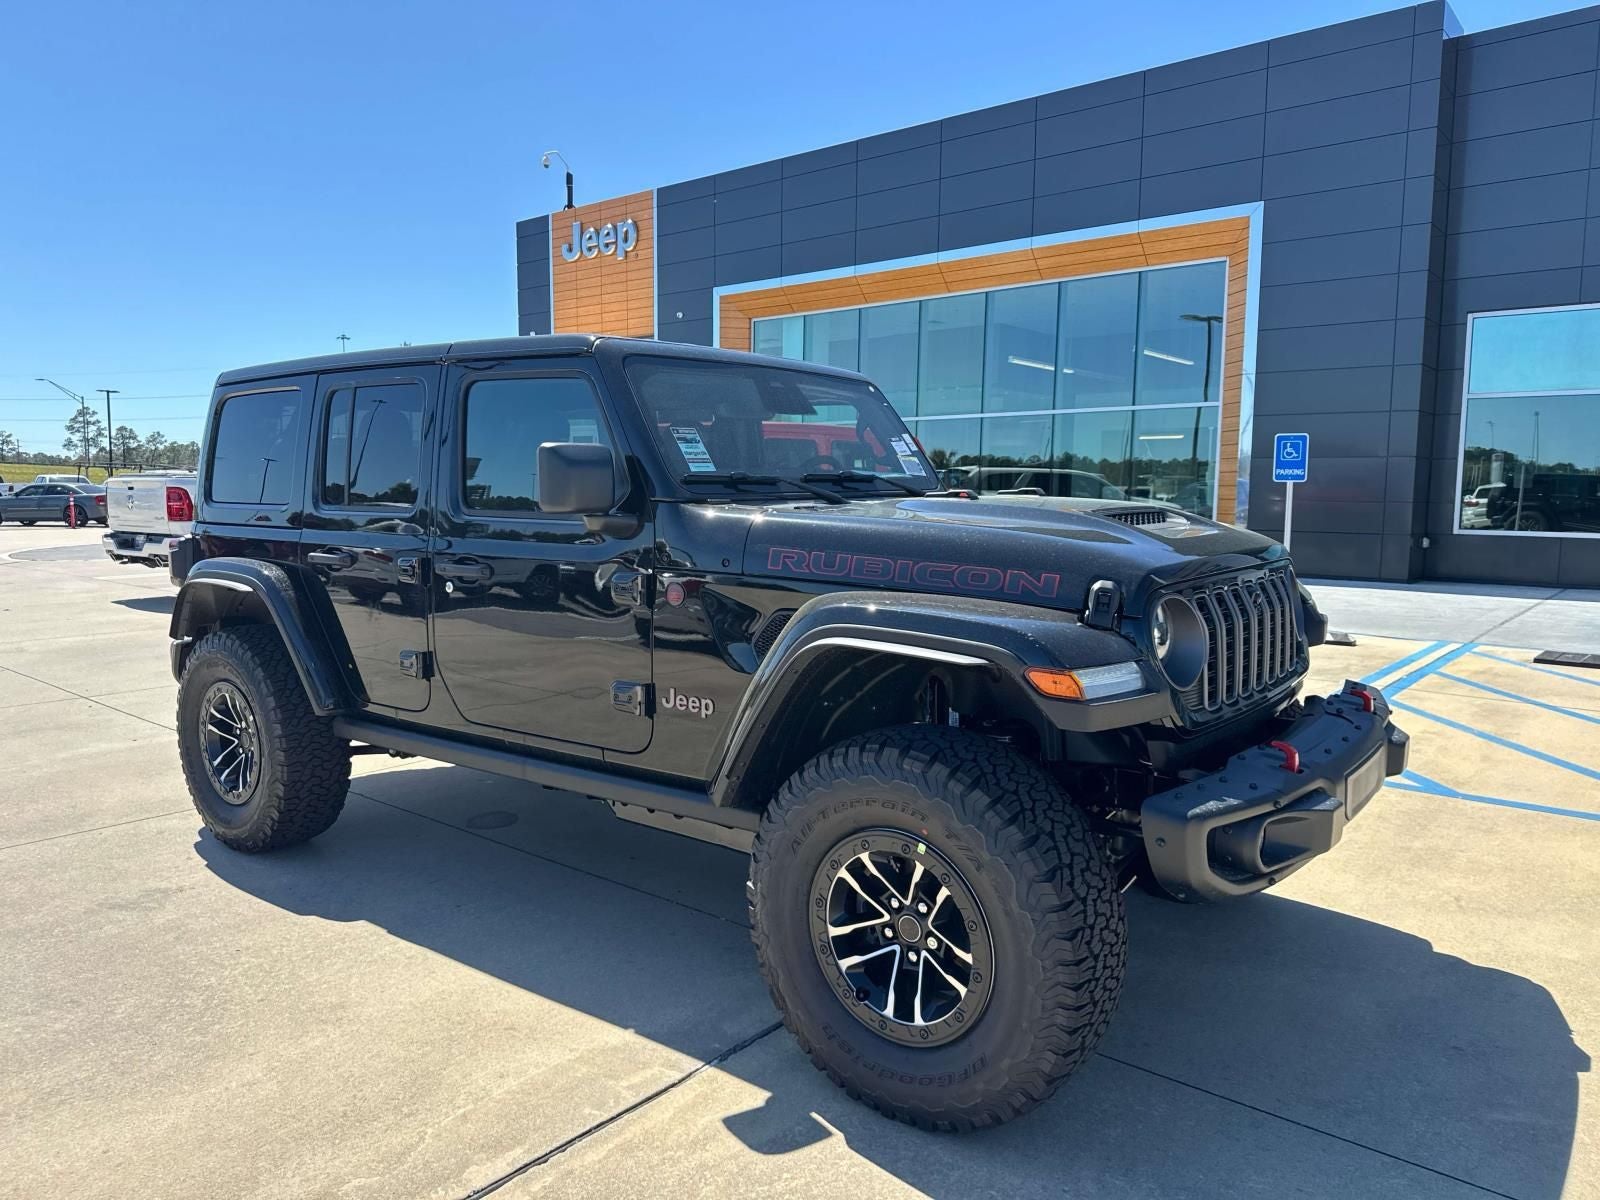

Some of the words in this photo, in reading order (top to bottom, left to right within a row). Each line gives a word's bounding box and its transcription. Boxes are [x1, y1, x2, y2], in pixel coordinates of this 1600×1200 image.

[561, 218, 638, 262] Jeep
[1275, 468, 1305, 476] PARKING
[767, 547, 1061, 598] RUBICON
[661, 687, 715, 719] Jeep
